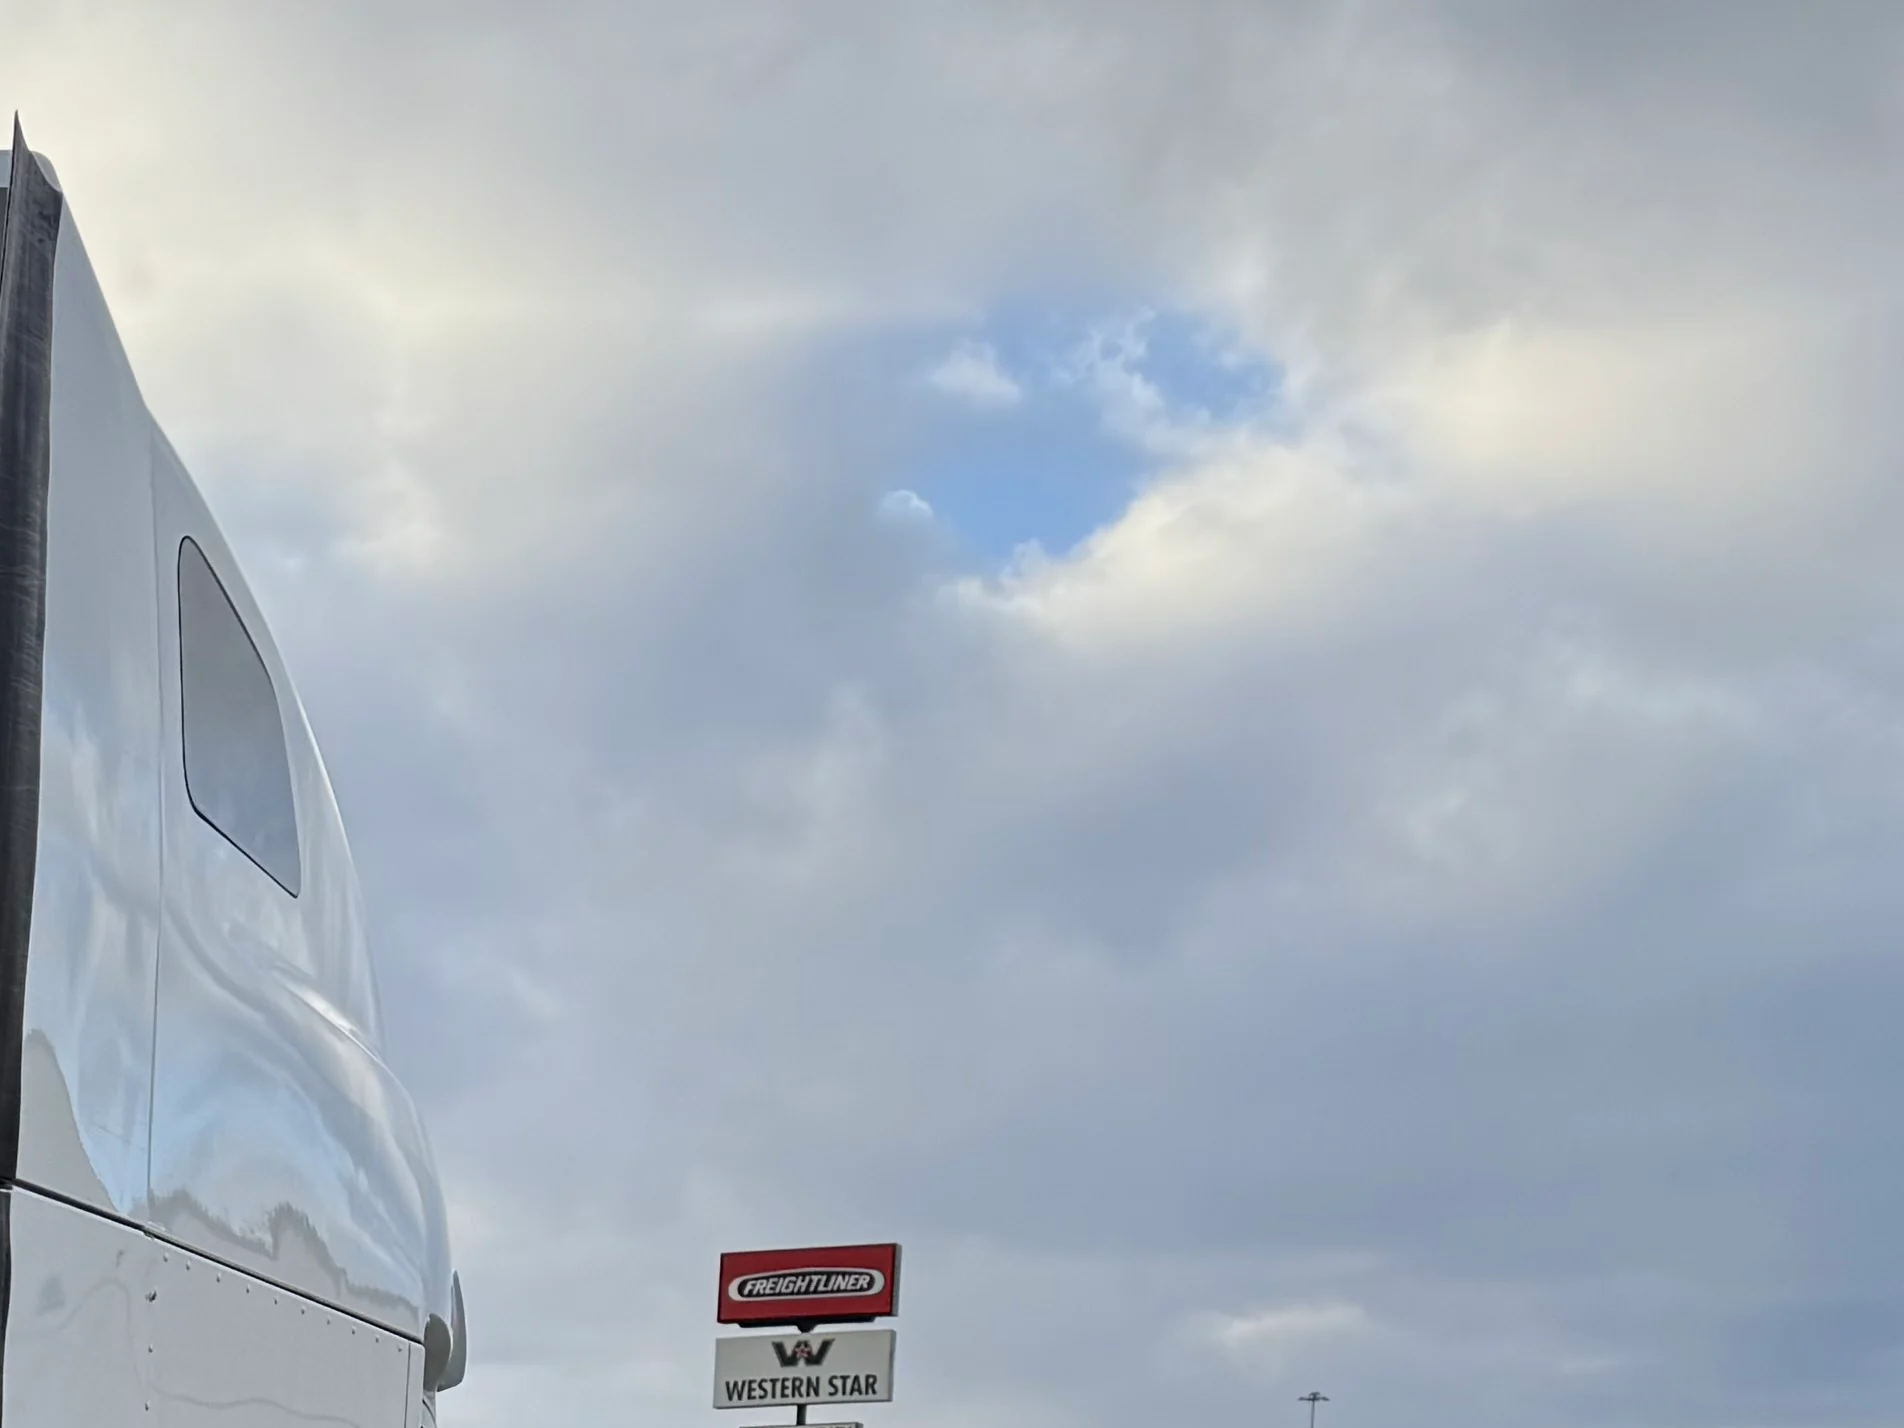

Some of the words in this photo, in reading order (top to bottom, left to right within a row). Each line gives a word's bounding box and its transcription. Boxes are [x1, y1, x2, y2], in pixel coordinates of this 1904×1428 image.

[743, 1274, 871, 1296] FREIGHTLINER
[725, 1376, 820, 1402] WESTERN
[828, 1374, 877, 1396] STAR
